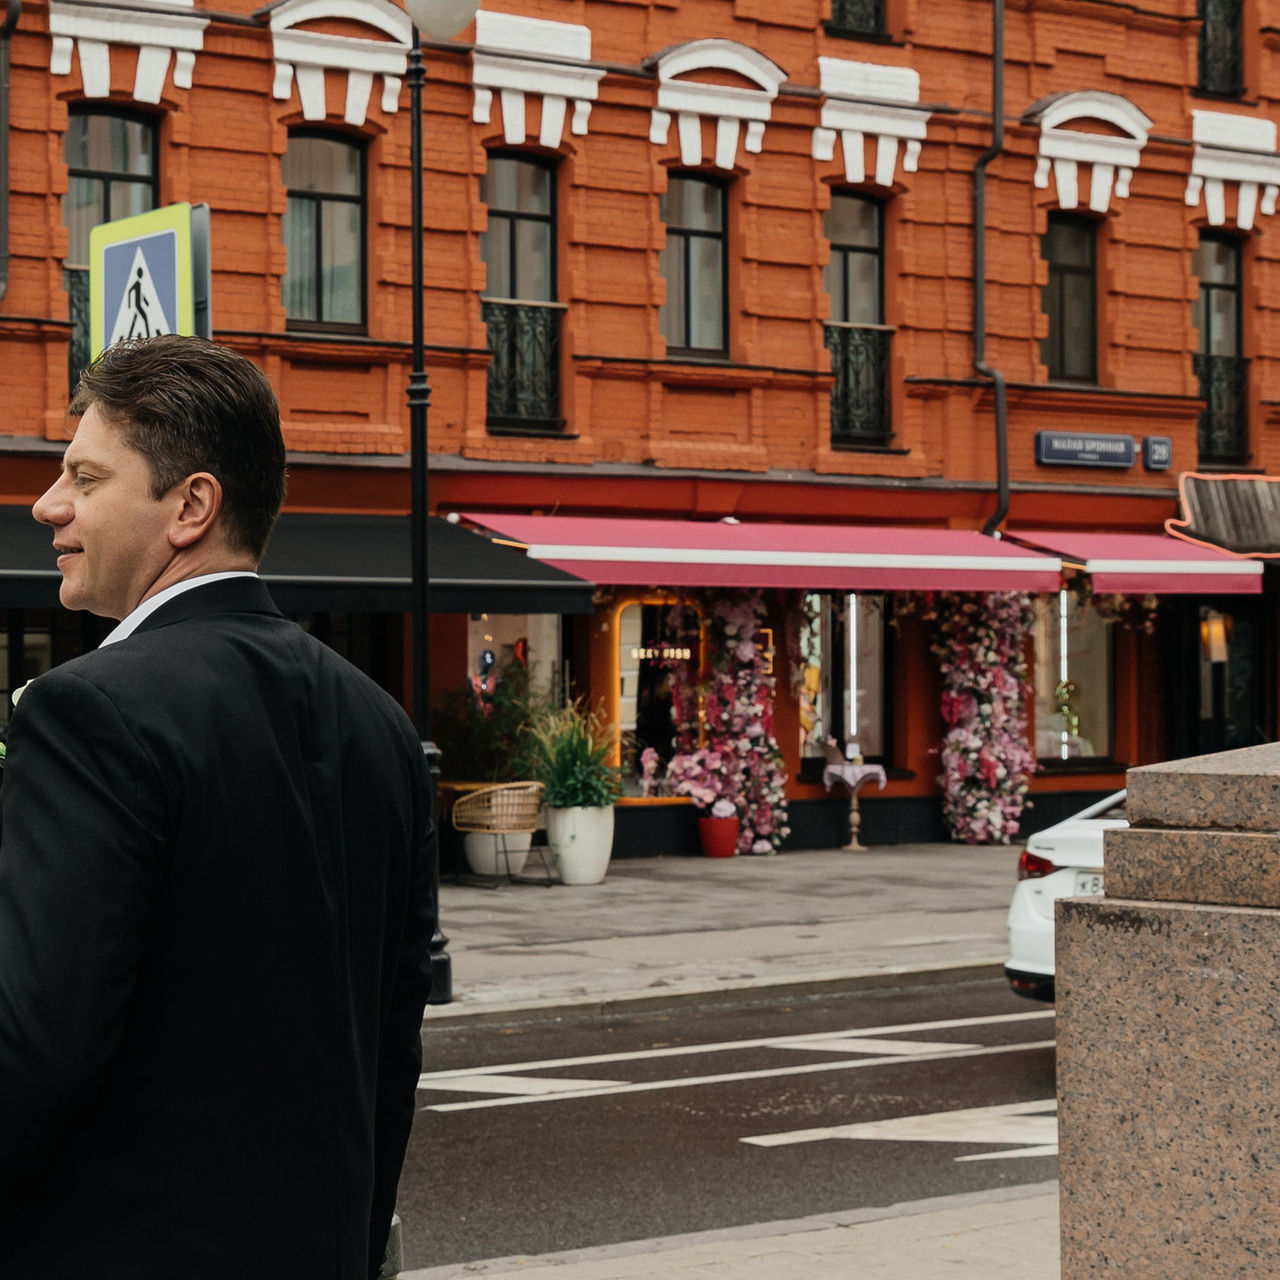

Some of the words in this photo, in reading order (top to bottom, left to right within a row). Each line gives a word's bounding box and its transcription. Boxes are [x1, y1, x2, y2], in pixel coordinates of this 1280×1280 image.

[1151, 443, 1169, 461] 28
[630, 648, 659, 660] SEXY
[663, 648, 691, 660] FISH
